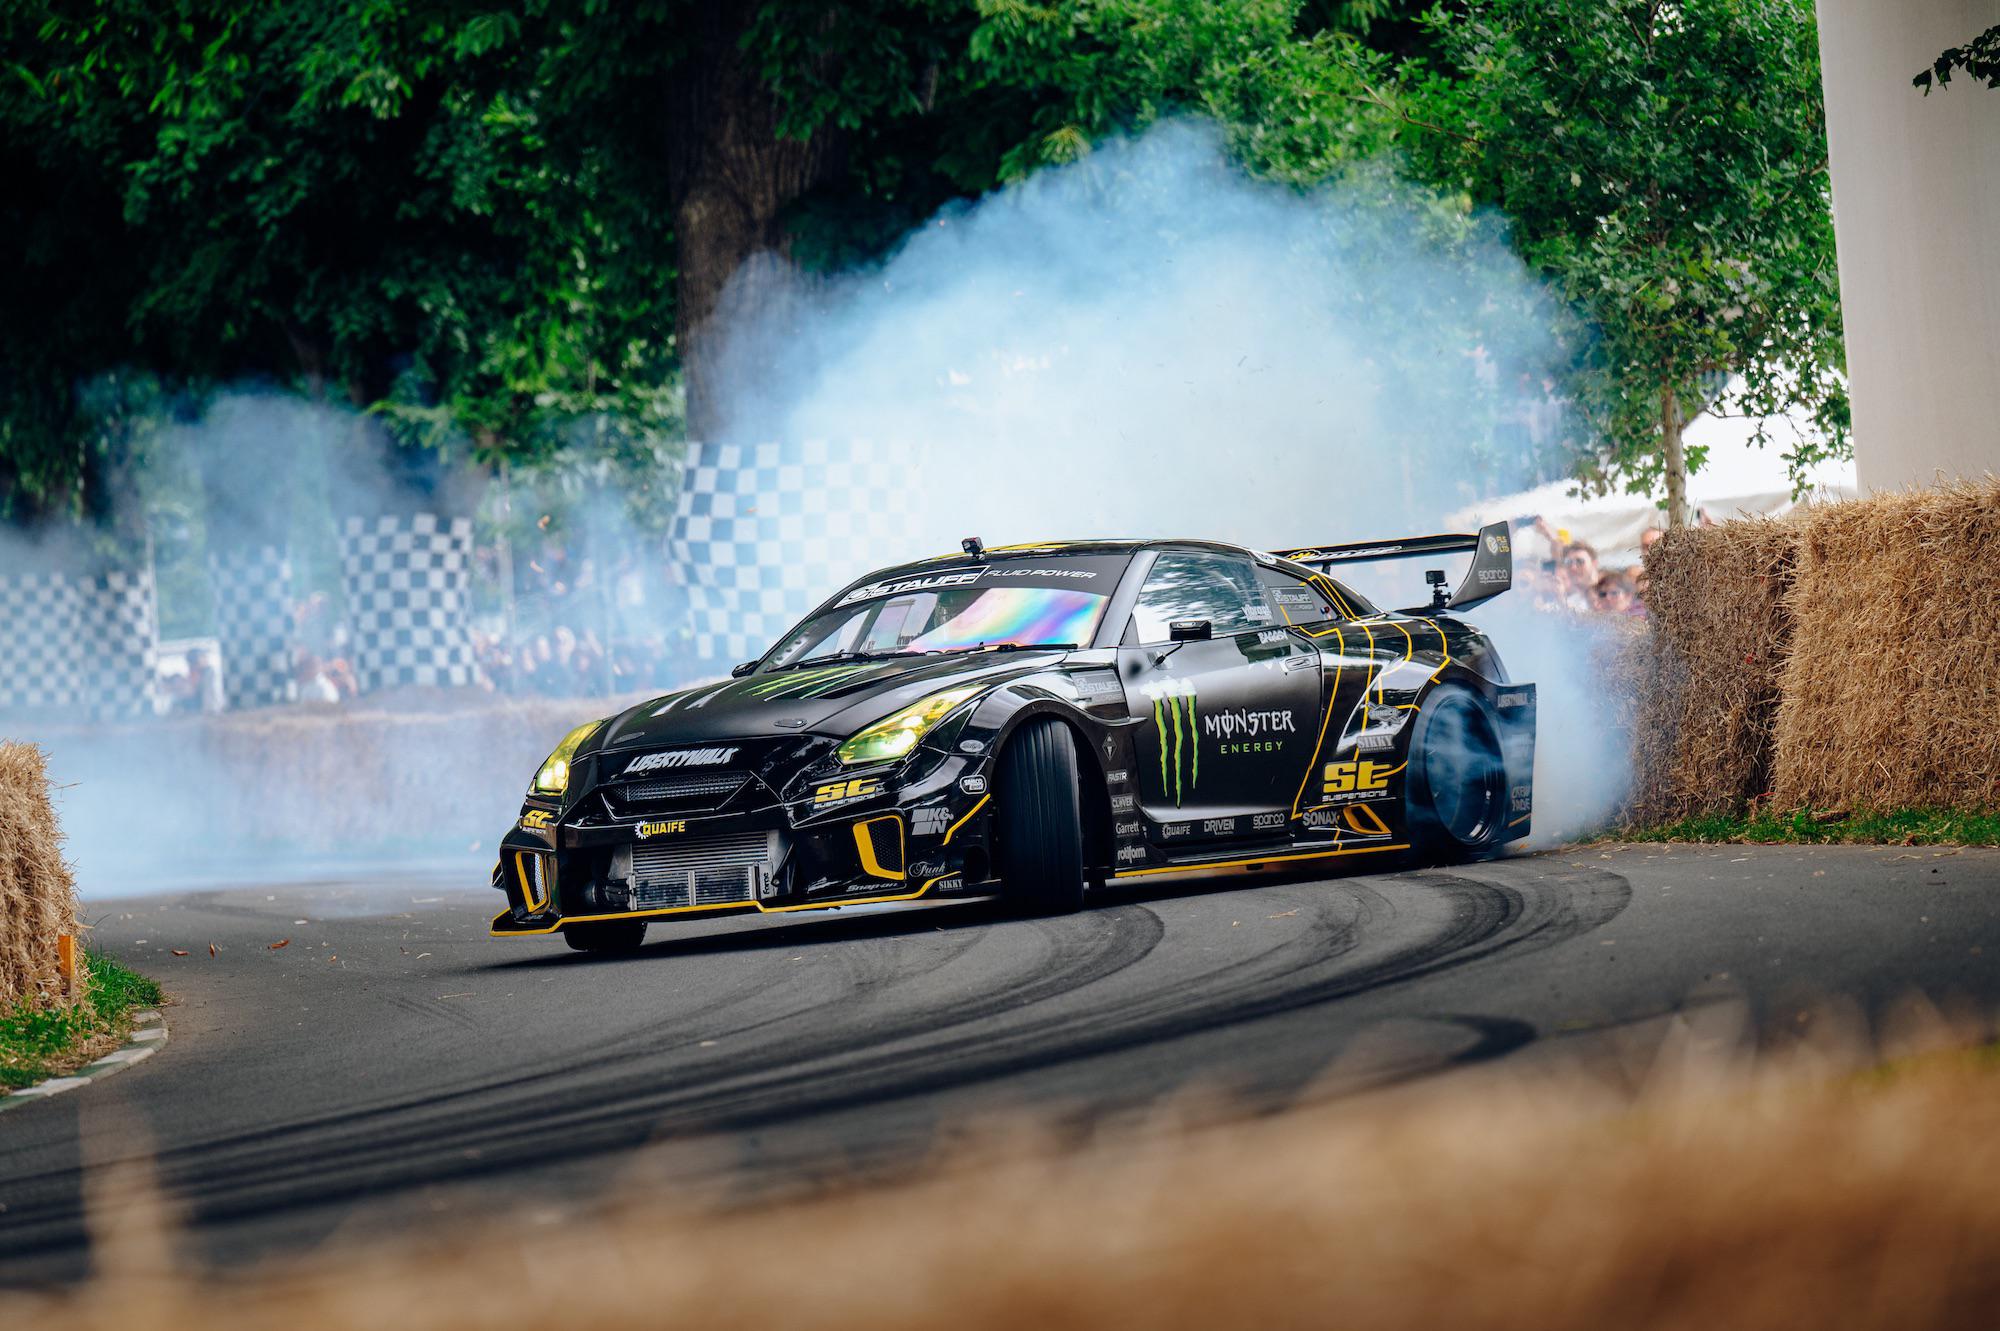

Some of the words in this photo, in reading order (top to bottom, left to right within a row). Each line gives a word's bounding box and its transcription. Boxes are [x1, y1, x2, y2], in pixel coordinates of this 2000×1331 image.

[869, 572, 980, 598] STAUFF
[984, 568, 1030, 578] FLUID
[1028, 568, 1098, 580] POWER
[1479, 569, 1508, 584] sparco
[1220, 741, 1283, 754] ENERGY
[1357, 735, 1393, 748] SIKKY
[623, 748, 742, 774] LIBERTYWALK
[1204, 818, 1235, 834] DRIVEN
[1253, 812, 1285, 829] sparco
[1303, 812, 1338, 826] SONAX
[643, 820, 686, 835] QUAIFE
[1115, 821, 1140, 834] Garrett
[1166, 825, 1191, 835] QUAIFE
[1117, 845, 1146, 864] rotiform
[908, 861, 946, 877] Funk
[846, 882, 898, 893] Snap-on
[939, 879, 963, 889] SIKKY
